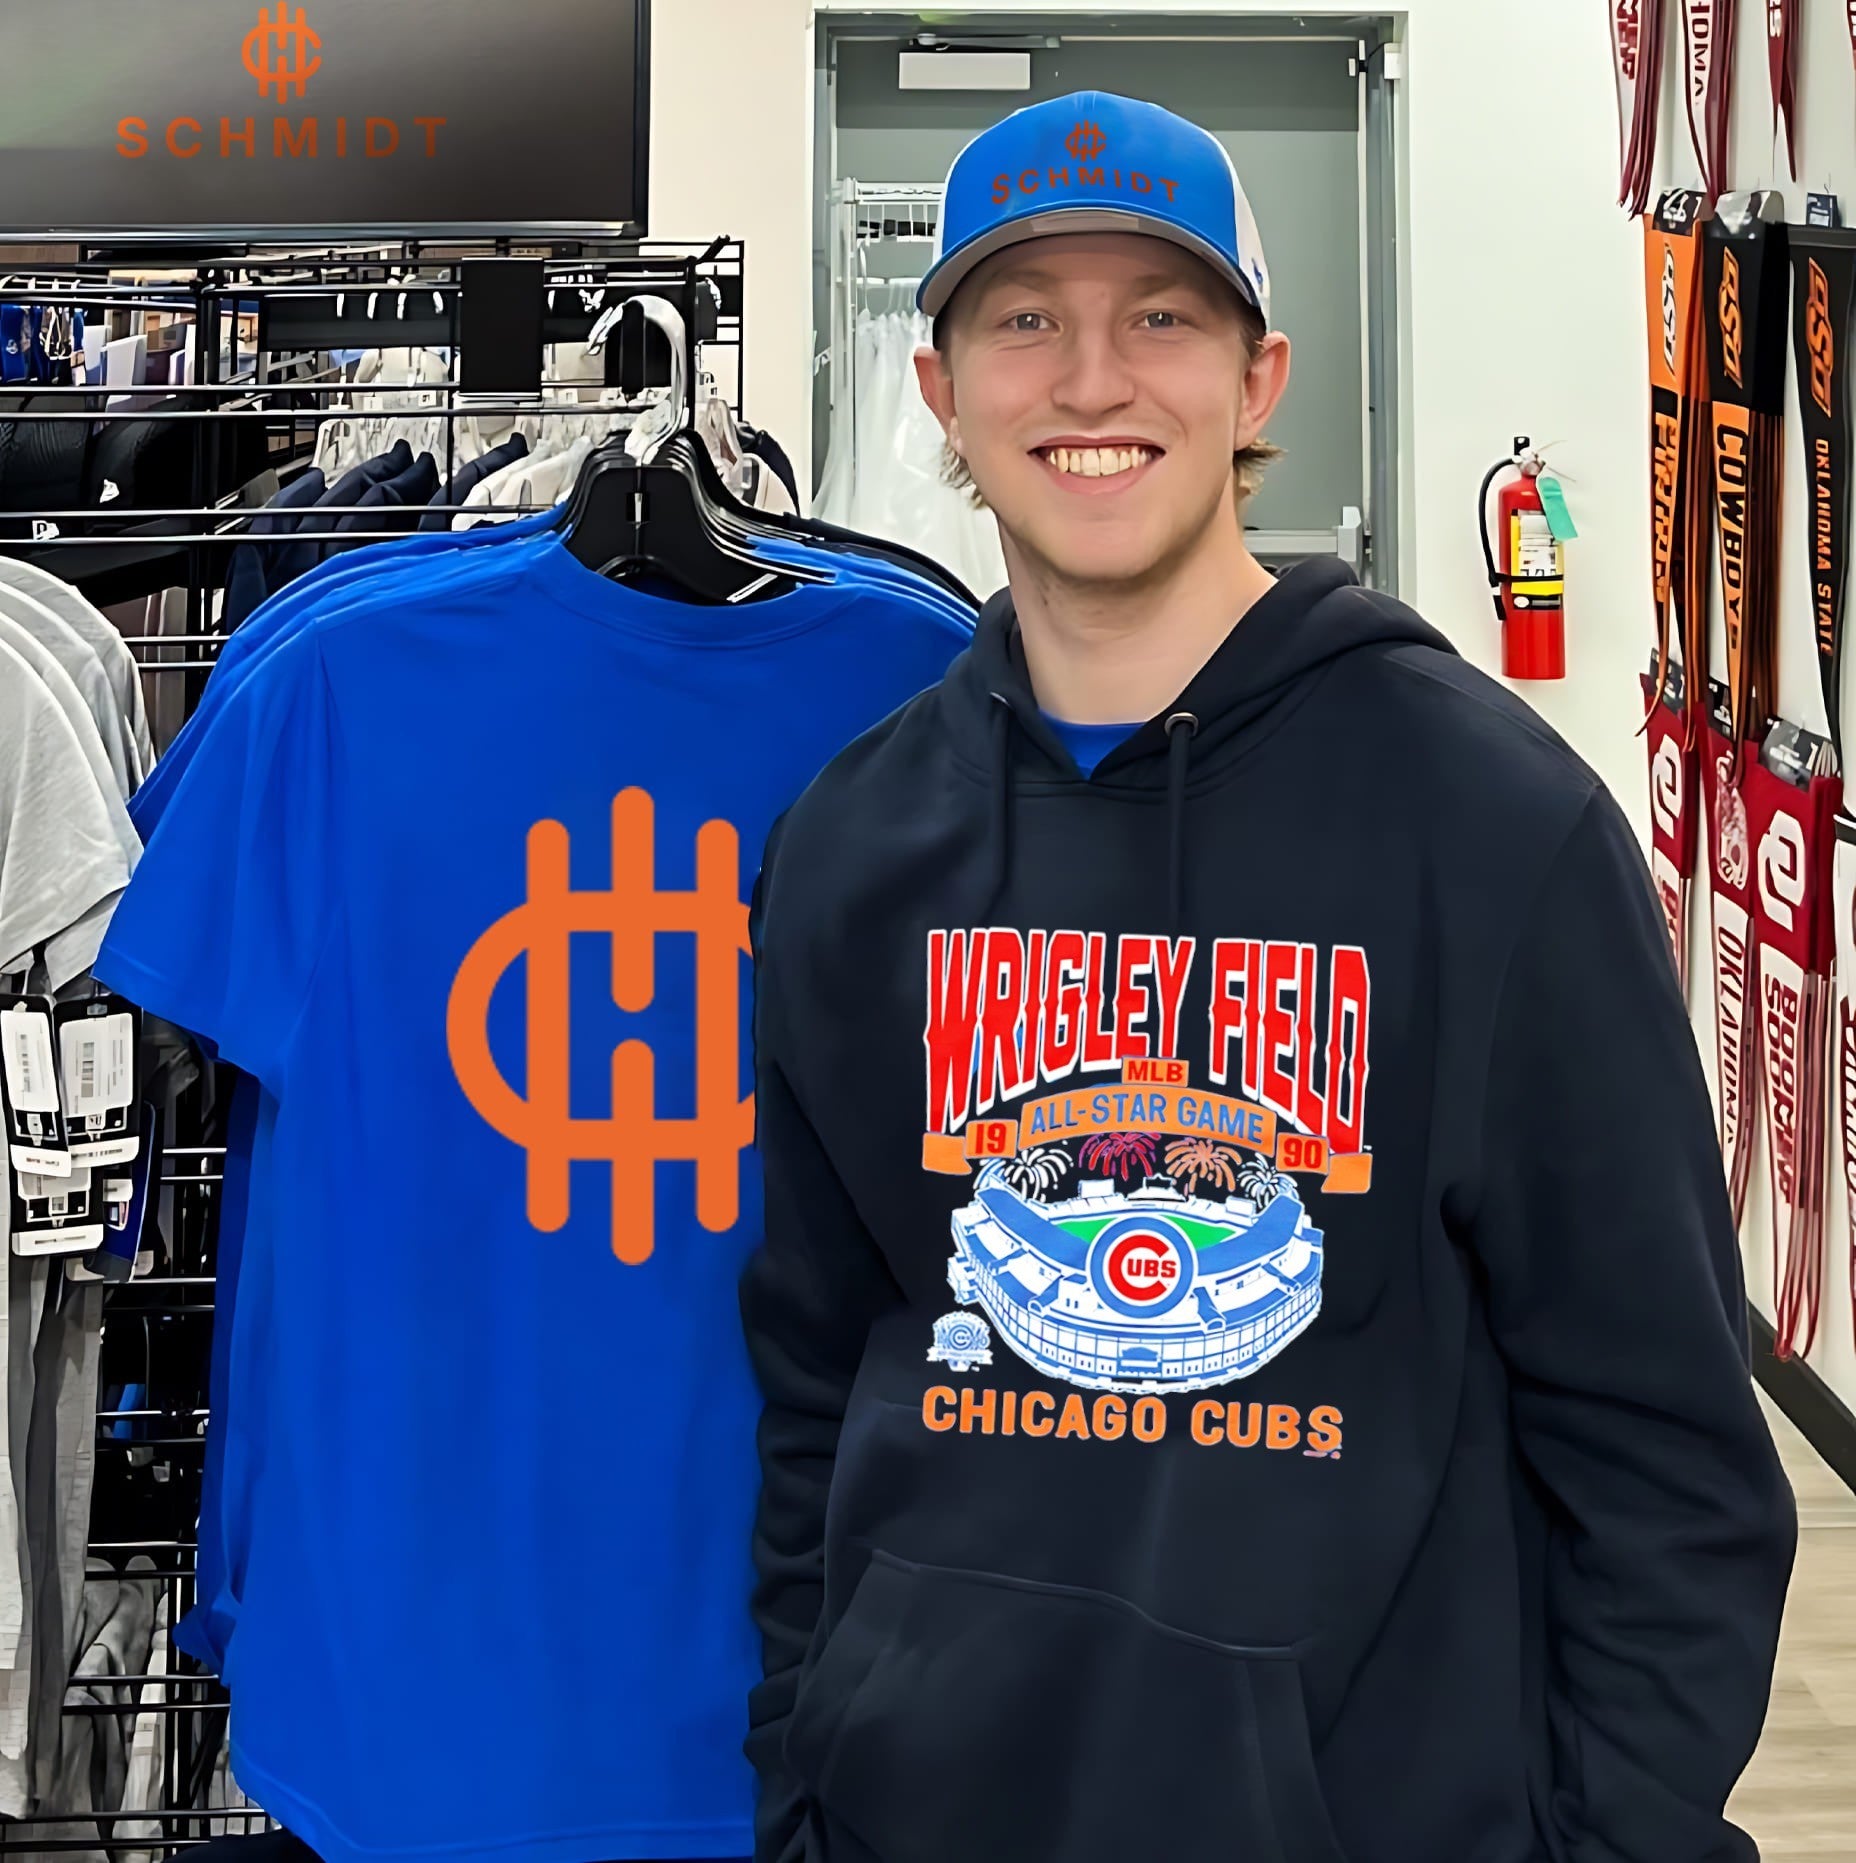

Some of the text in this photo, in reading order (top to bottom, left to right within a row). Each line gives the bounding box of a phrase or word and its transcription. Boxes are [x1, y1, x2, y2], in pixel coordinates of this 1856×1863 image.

[115, 117, 447, 158] SCHMIDT
[991, 167, 1179, 204] SCHMIDT
[923, 927, 1370, 1154] WRIGLEY FIELD
[1718, 925, 1745, 1144] OKLAHOMA
[1127, 1060, 1184, 1084] MLB
[974, 1122, 1007, 1154] 19
[1030, 1093, 1265, 1144] ALL-STAR GAME
[1283, 1138, 1322, 1170] 90
[922, 1385, 1343, 1453] CHICAGO CUBS
